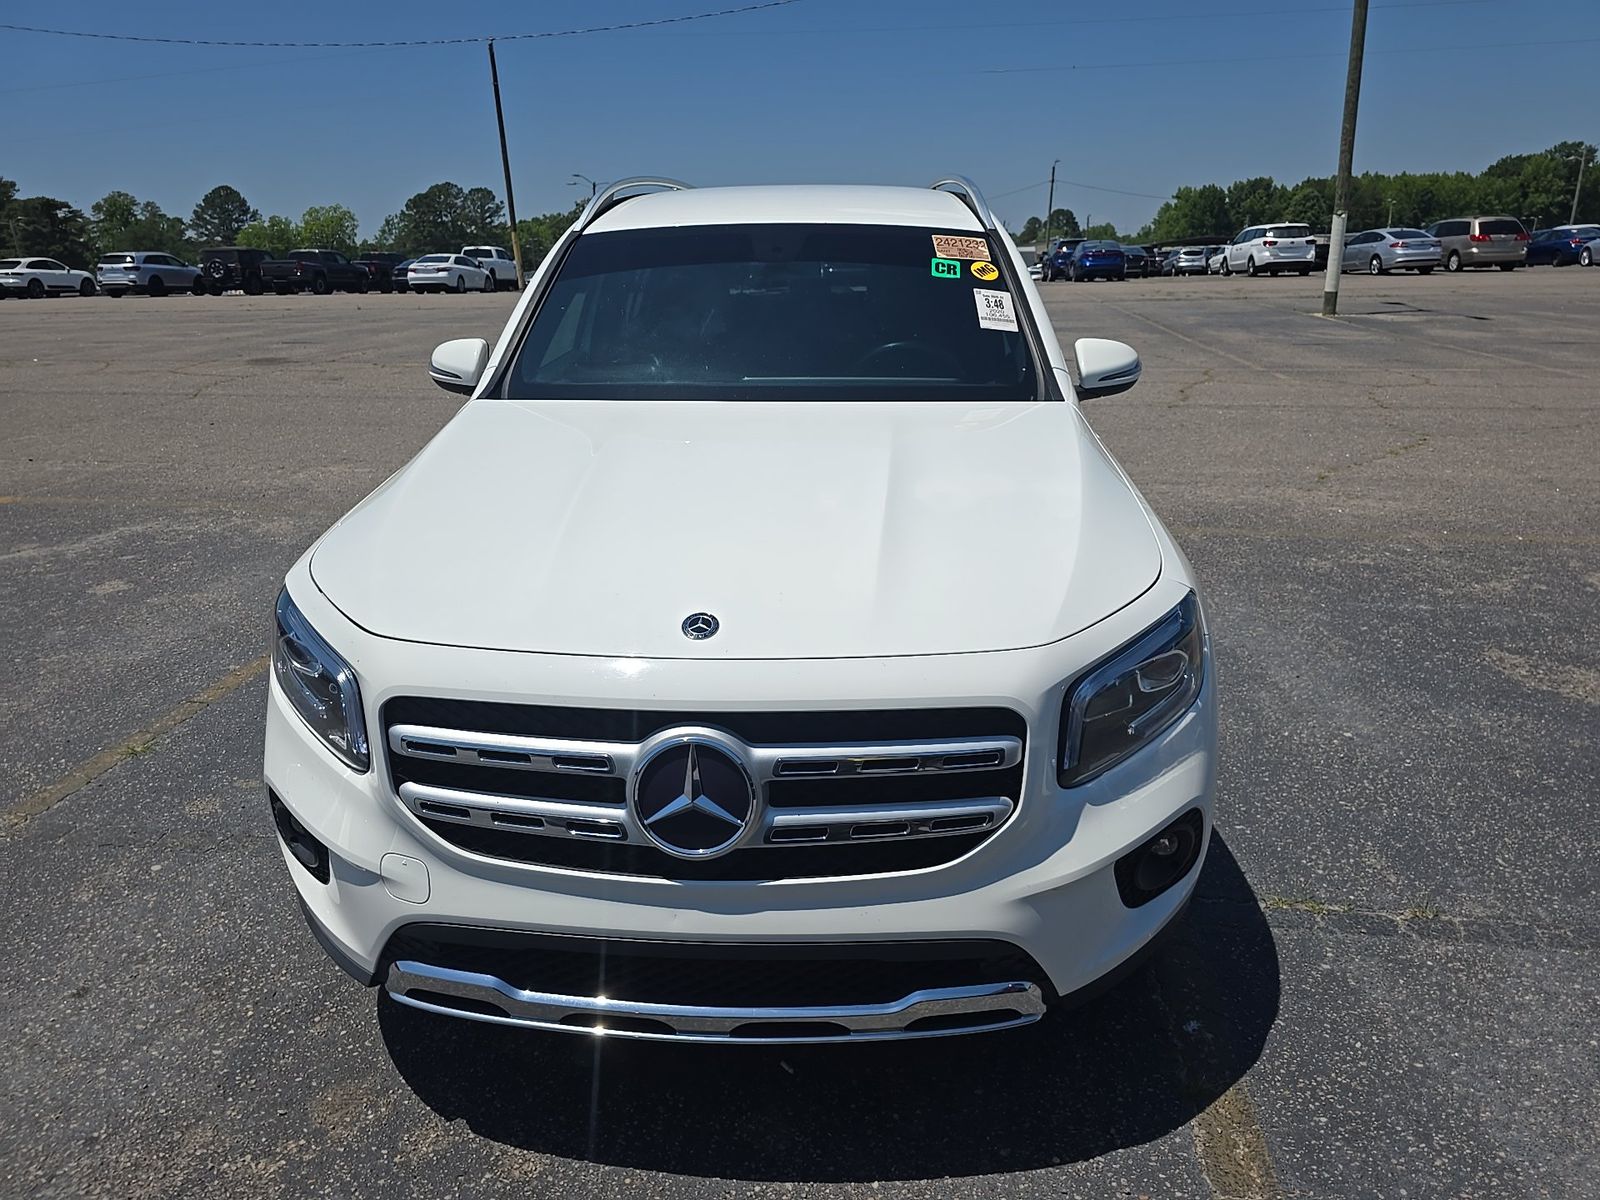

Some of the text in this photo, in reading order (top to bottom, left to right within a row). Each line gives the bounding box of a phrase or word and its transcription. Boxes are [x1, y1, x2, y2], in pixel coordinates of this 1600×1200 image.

[935, 262, 957, 275] CR
[973, 264, 996, 277] IMG
[984, 298, 1005, 309] 3:48
